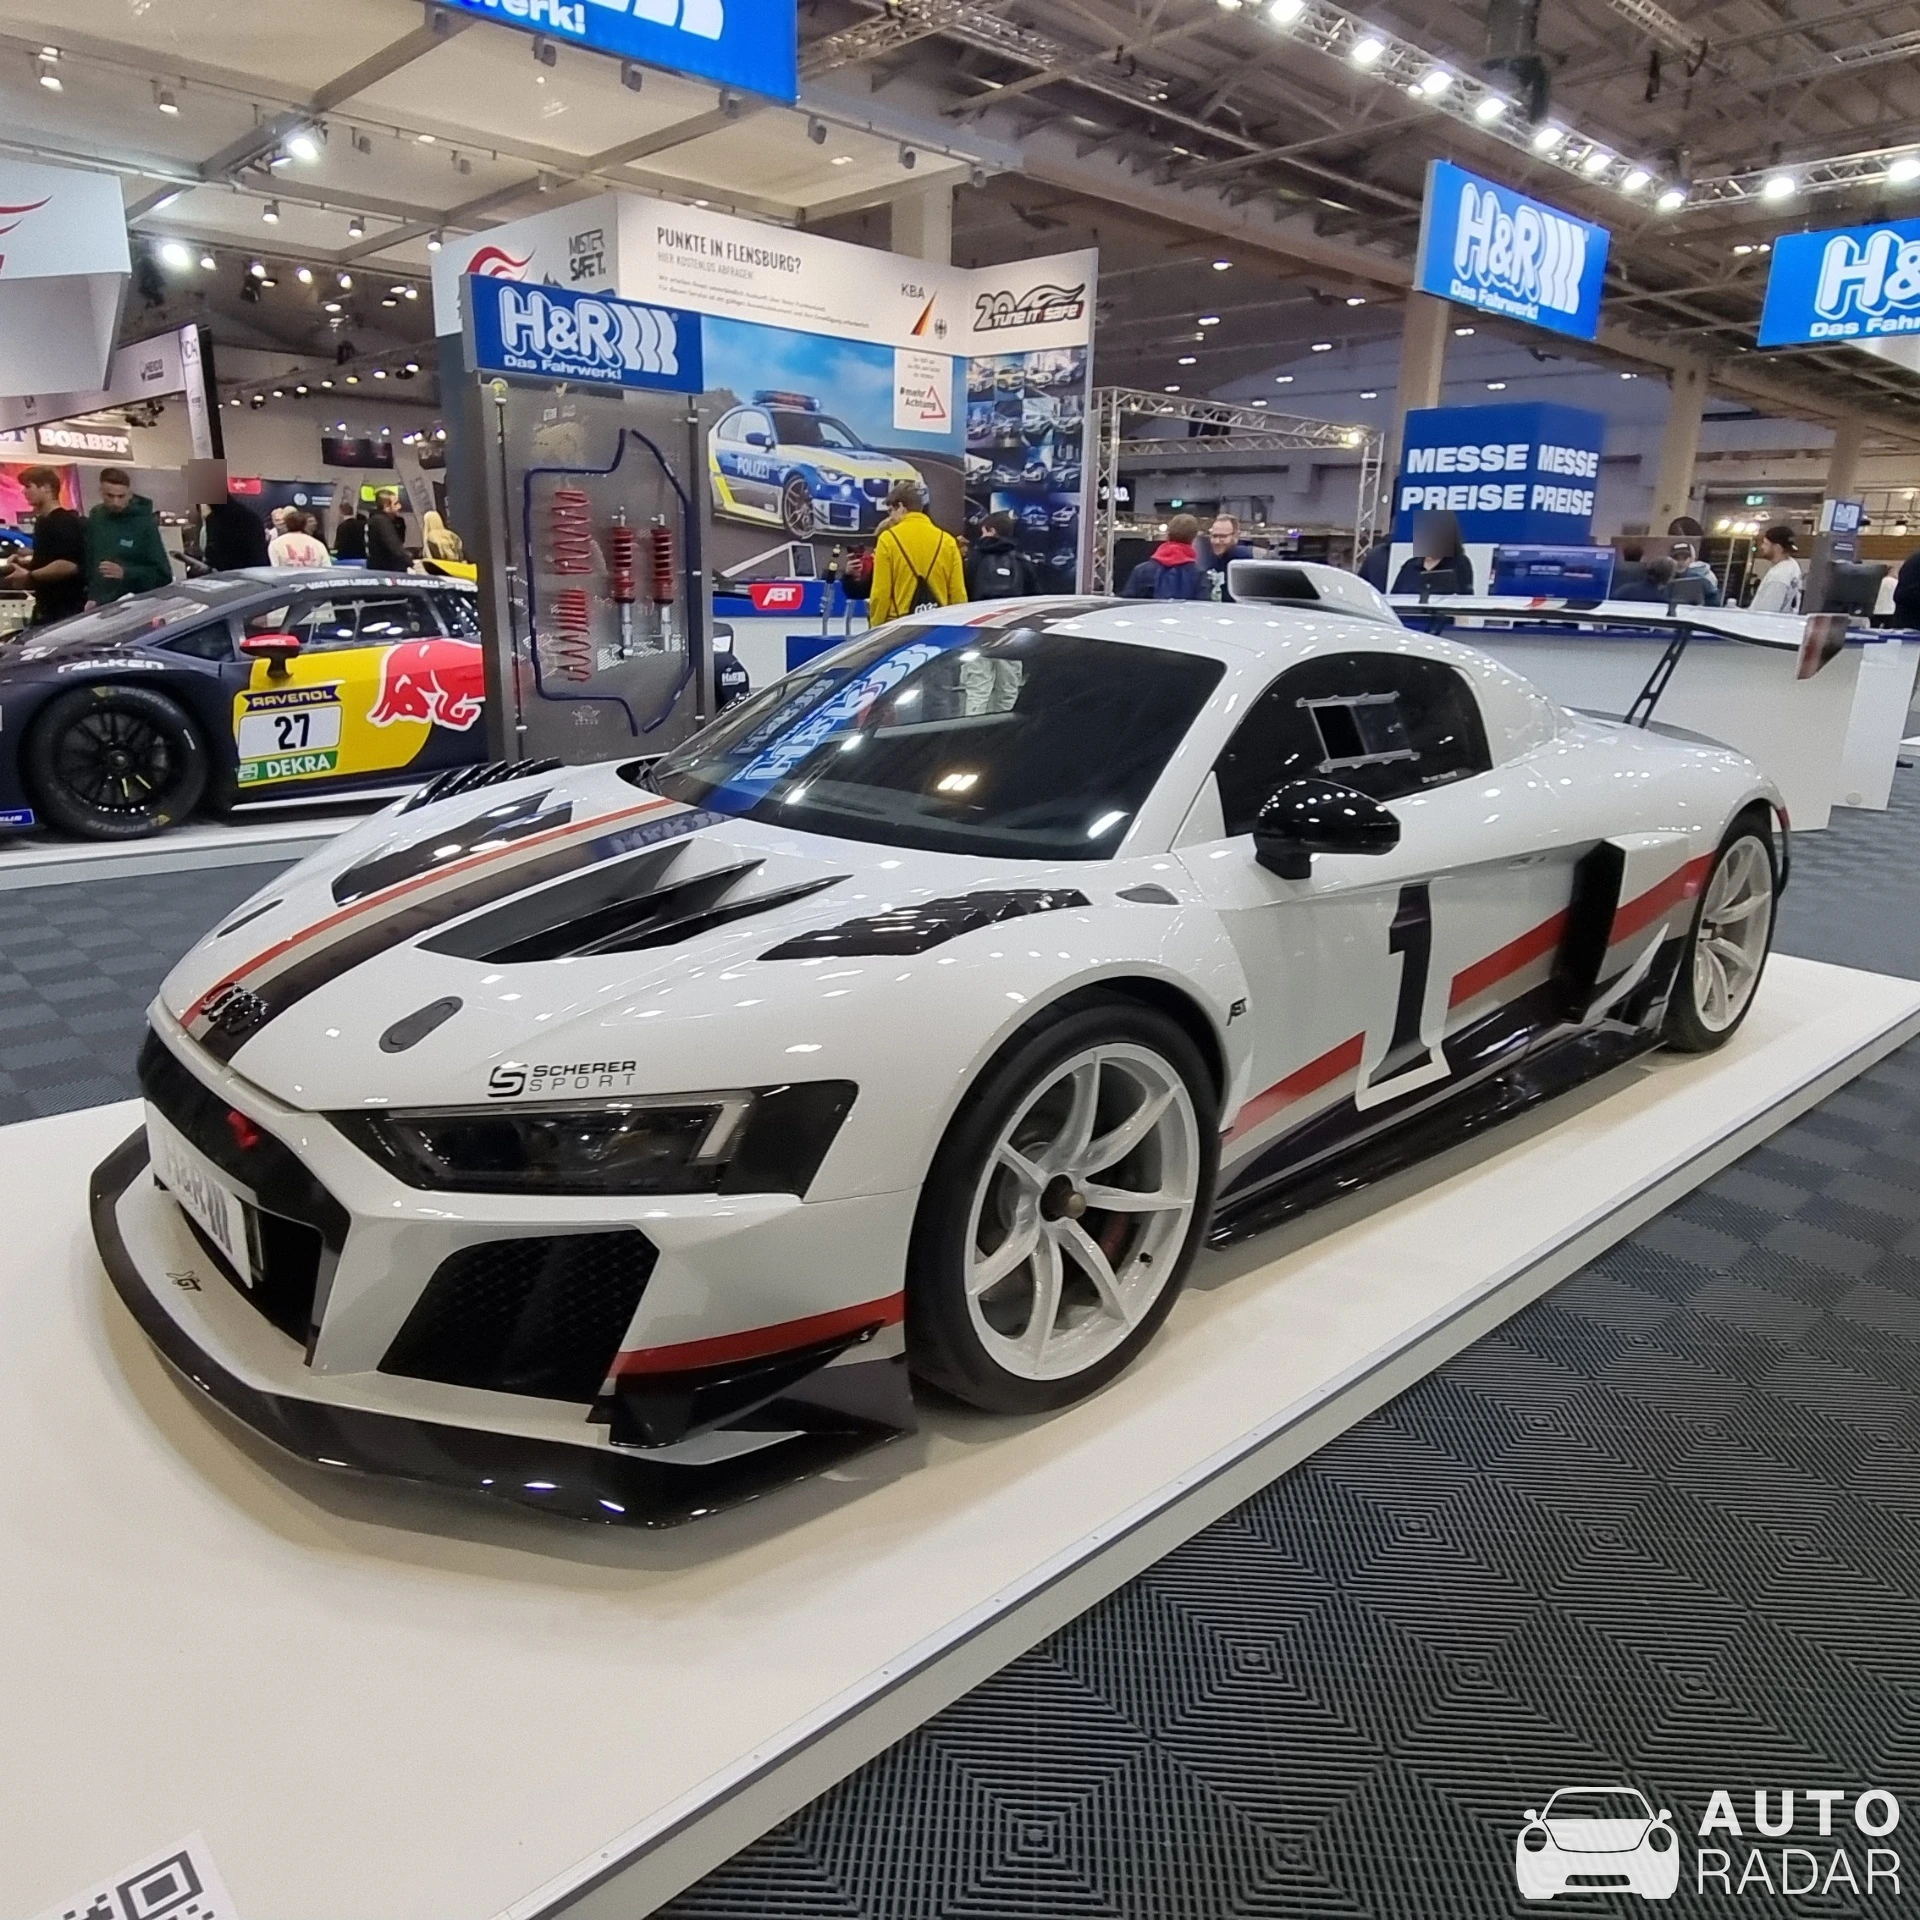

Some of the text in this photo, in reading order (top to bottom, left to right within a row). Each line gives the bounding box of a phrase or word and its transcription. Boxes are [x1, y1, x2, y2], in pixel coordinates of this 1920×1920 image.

[657, 227, 801, 275] PUNKTE IN FLENSBURG?
[1454, 182, 1546, 303] H&R
[901, 283, 925, 299] KBA
[499, 287, 622, 368] H&R
[1809, 322, 1860, 338] Das
[504, 355, 537, 370] Das
[38, 428, 130, 454] BORBET
[737, 457, 770, 479] POLIZEI
[1407, 444, 1530, 474] MESSE
[1537, 444, 1599, 478] MESSE
[1401, 484, 1527, 512] PREISE
[1530, 484, 1595, 516] PREISE
[762, 587, 796, 606] ABT
[252, 690, 333, 707] RAVENOL
[274, 713, 310, 750] 27
[266, 754, 331, 778] DEKRA
[1366, 884, 1436, 1090] 1
[529, 1073, 636, 1092] SPORT
[532, 1061, 637, 1078] SCHERER
